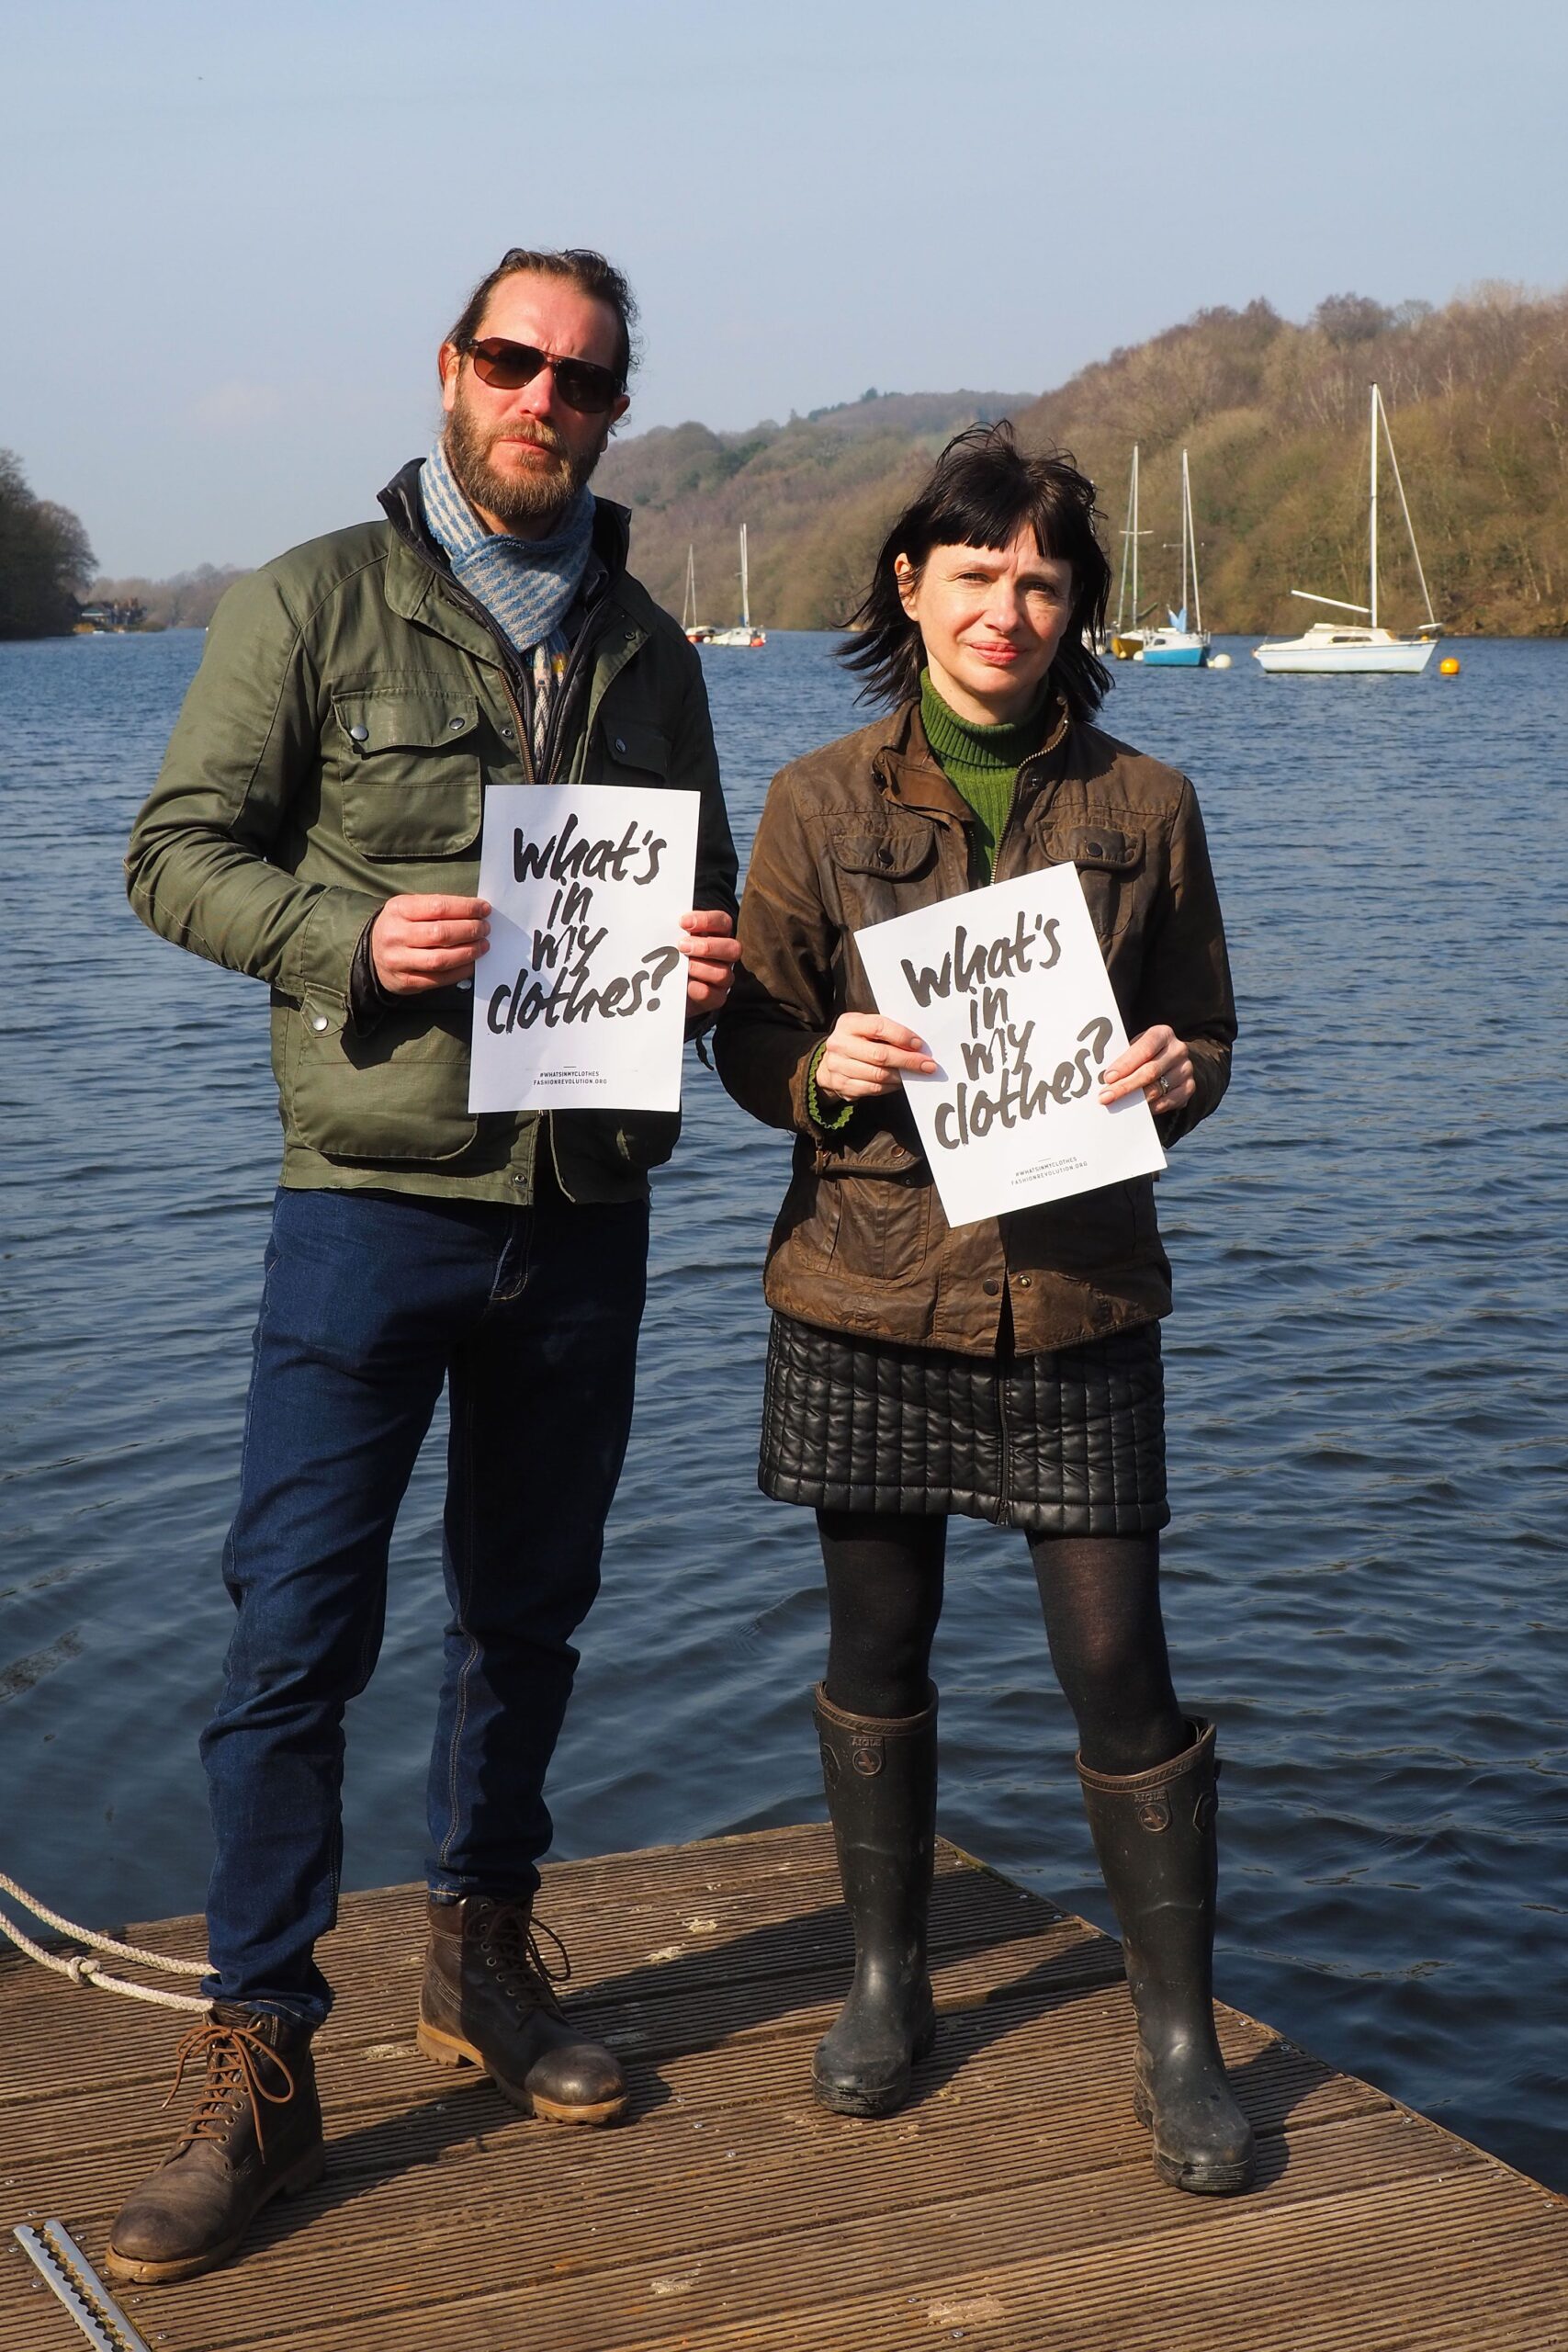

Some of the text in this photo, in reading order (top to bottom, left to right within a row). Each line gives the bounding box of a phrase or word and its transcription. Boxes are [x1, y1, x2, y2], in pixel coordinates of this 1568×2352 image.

[547, 876, 593, 931] in
[532, 924, 609, 978] my
[486, 945, 681, 1035] clothes?
[969, 985, 1009, 1039] in
[960, 1020, 1036, 1081] my
[934, 1016, 1114, 1150] clothes?
[1010, 1160, 1089, 1186] FASHIONREVOLUTION.ORG
[1015, 1156, 1077, 1177] #WHATSINMYCLOTHES
